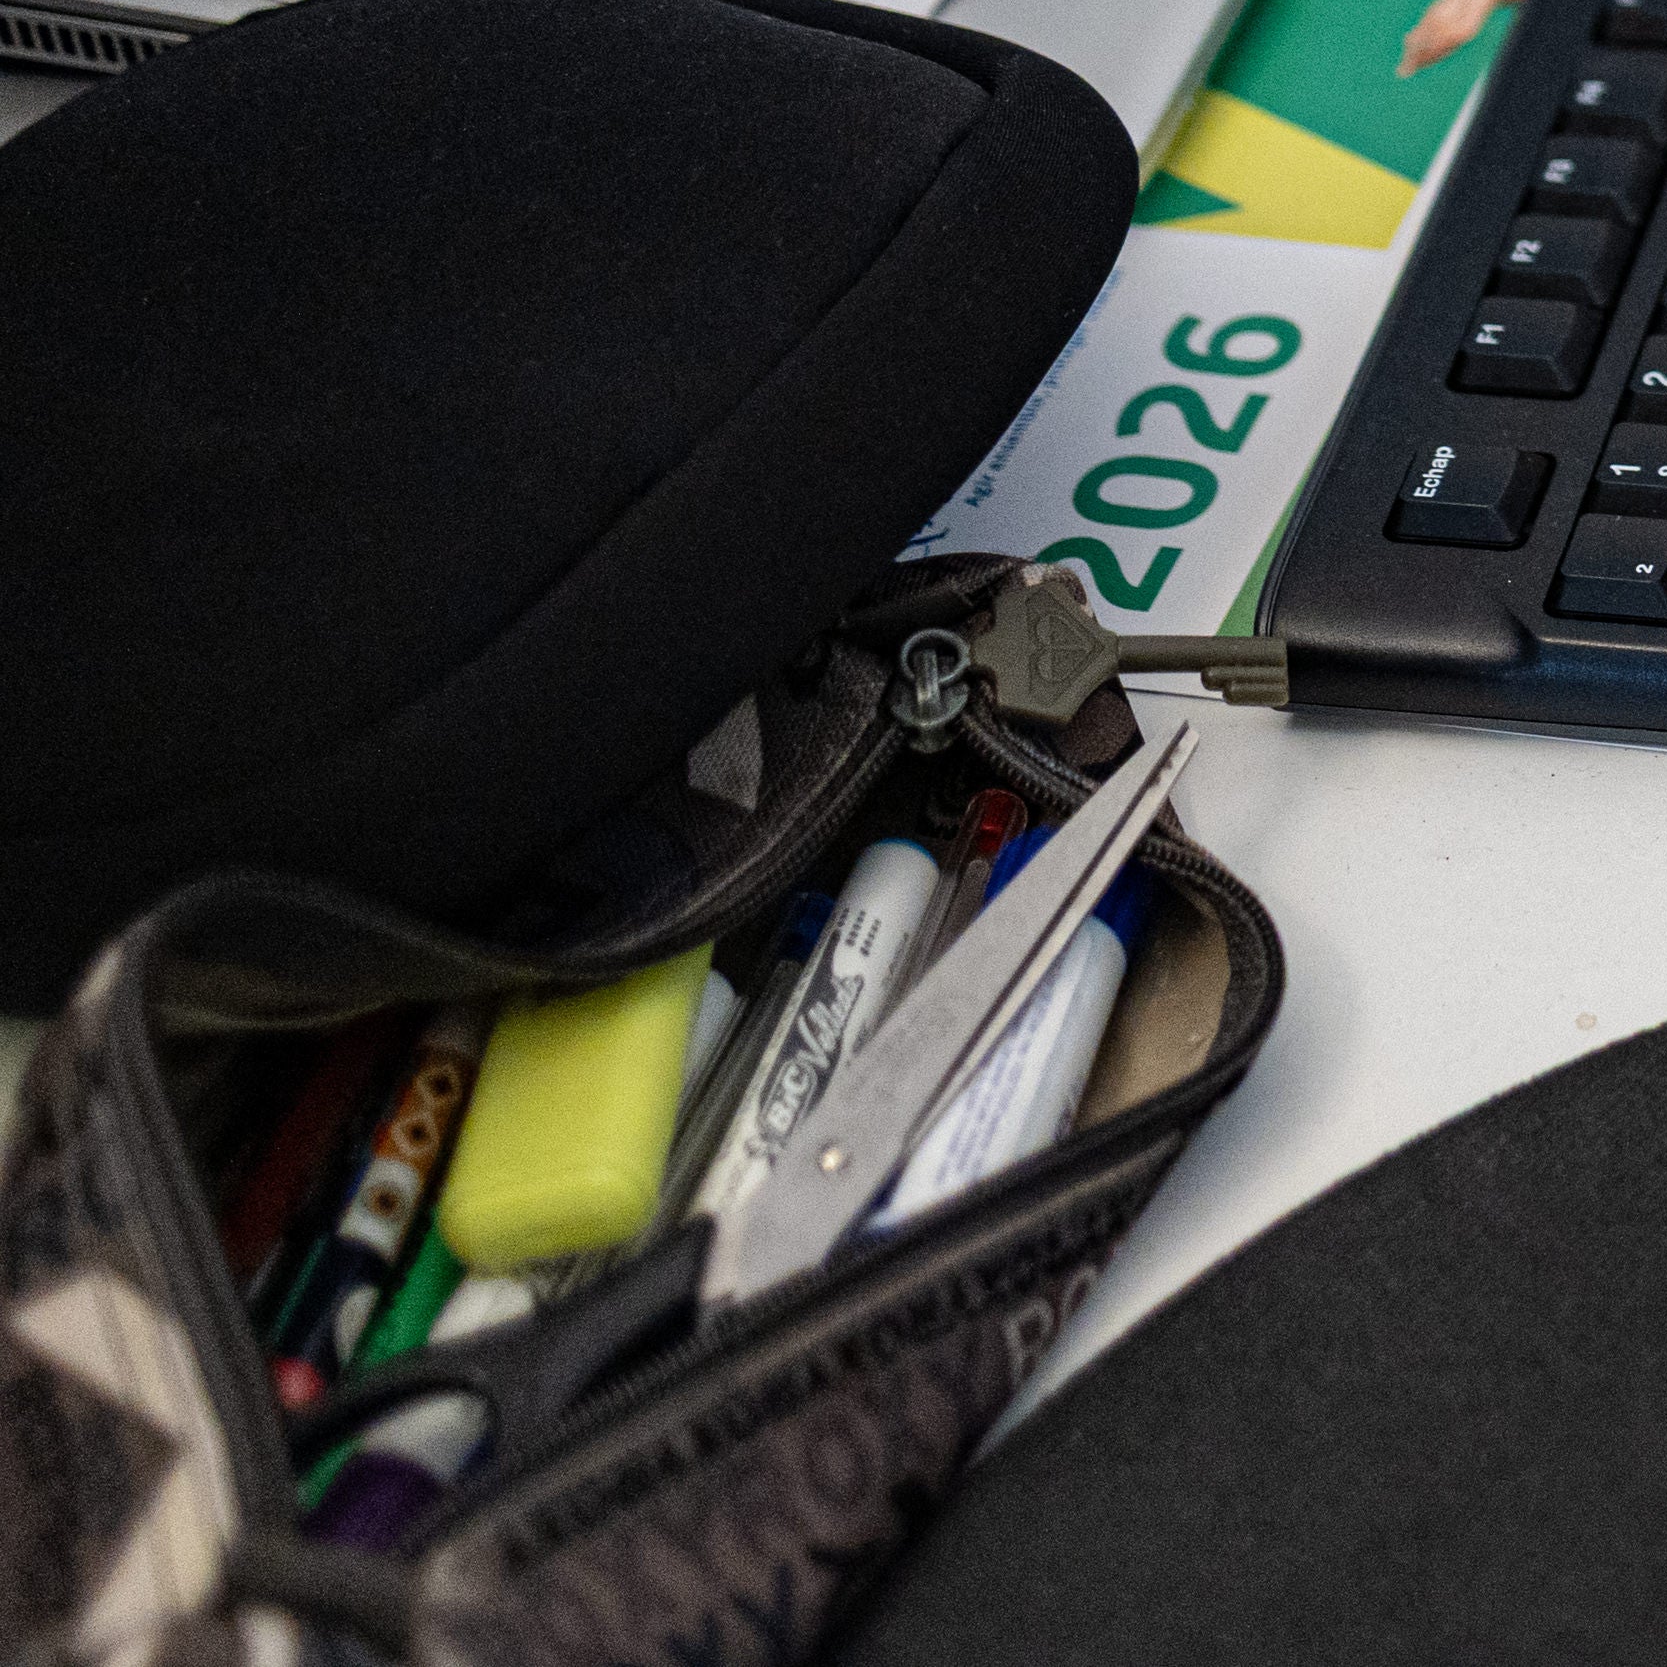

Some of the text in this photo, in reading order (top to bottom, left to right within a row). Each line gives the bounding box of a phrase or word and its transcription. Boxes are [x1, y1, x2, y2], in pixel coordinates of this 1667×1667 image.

[1510, 238, 1543, 264] F2
[1475, 323, 1505, 346] F1
[1034, 314, 1303, 613] 2026
[1413, 445, 1457, 499] Echap
[1610, 463, 1641, 476] 1
